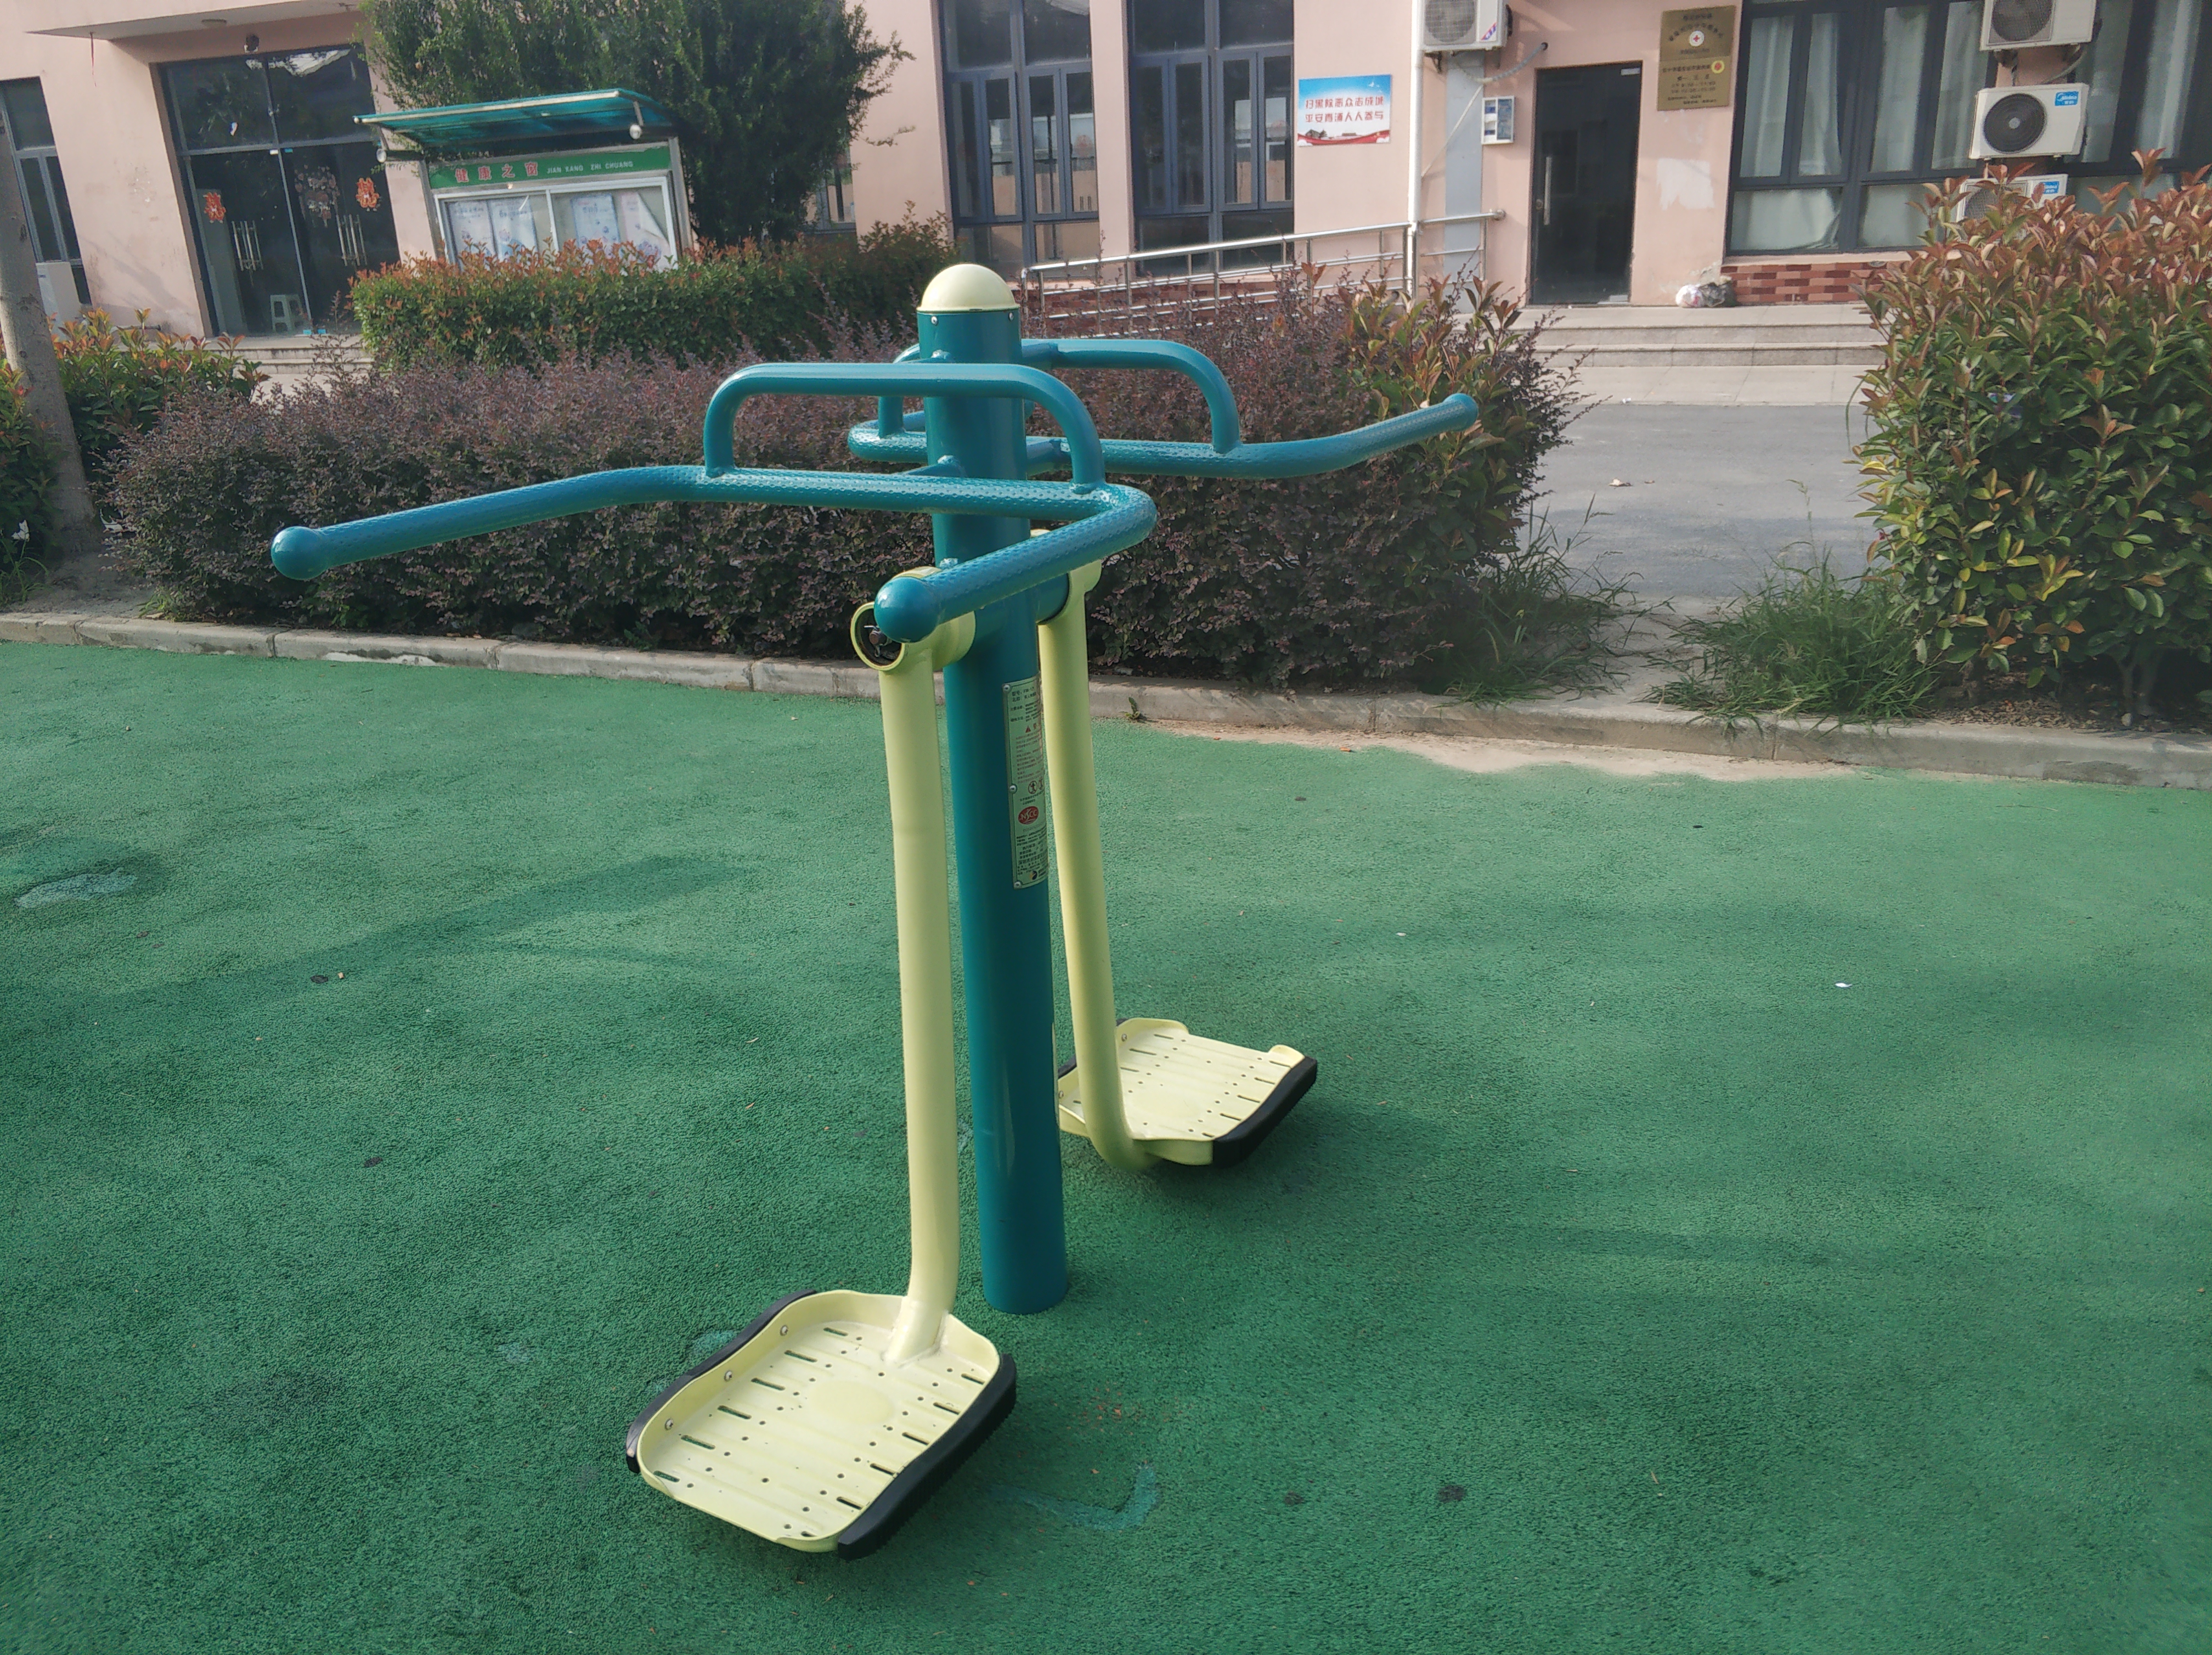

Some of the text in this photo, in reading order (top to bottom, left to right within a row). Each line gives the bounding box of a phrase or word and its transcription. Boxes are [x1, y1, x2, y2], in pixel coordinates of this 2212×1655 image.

[1306, 96, 1384, 109] 扫黑除恶众志成城
[1306, 111, 1384, 123] 平安青浦人人参与
[455, 161, 538, 183] 健康之窗
[605, 161, 634, 170] CHUANG
[1020, 808, 1037, 821] NSCC
